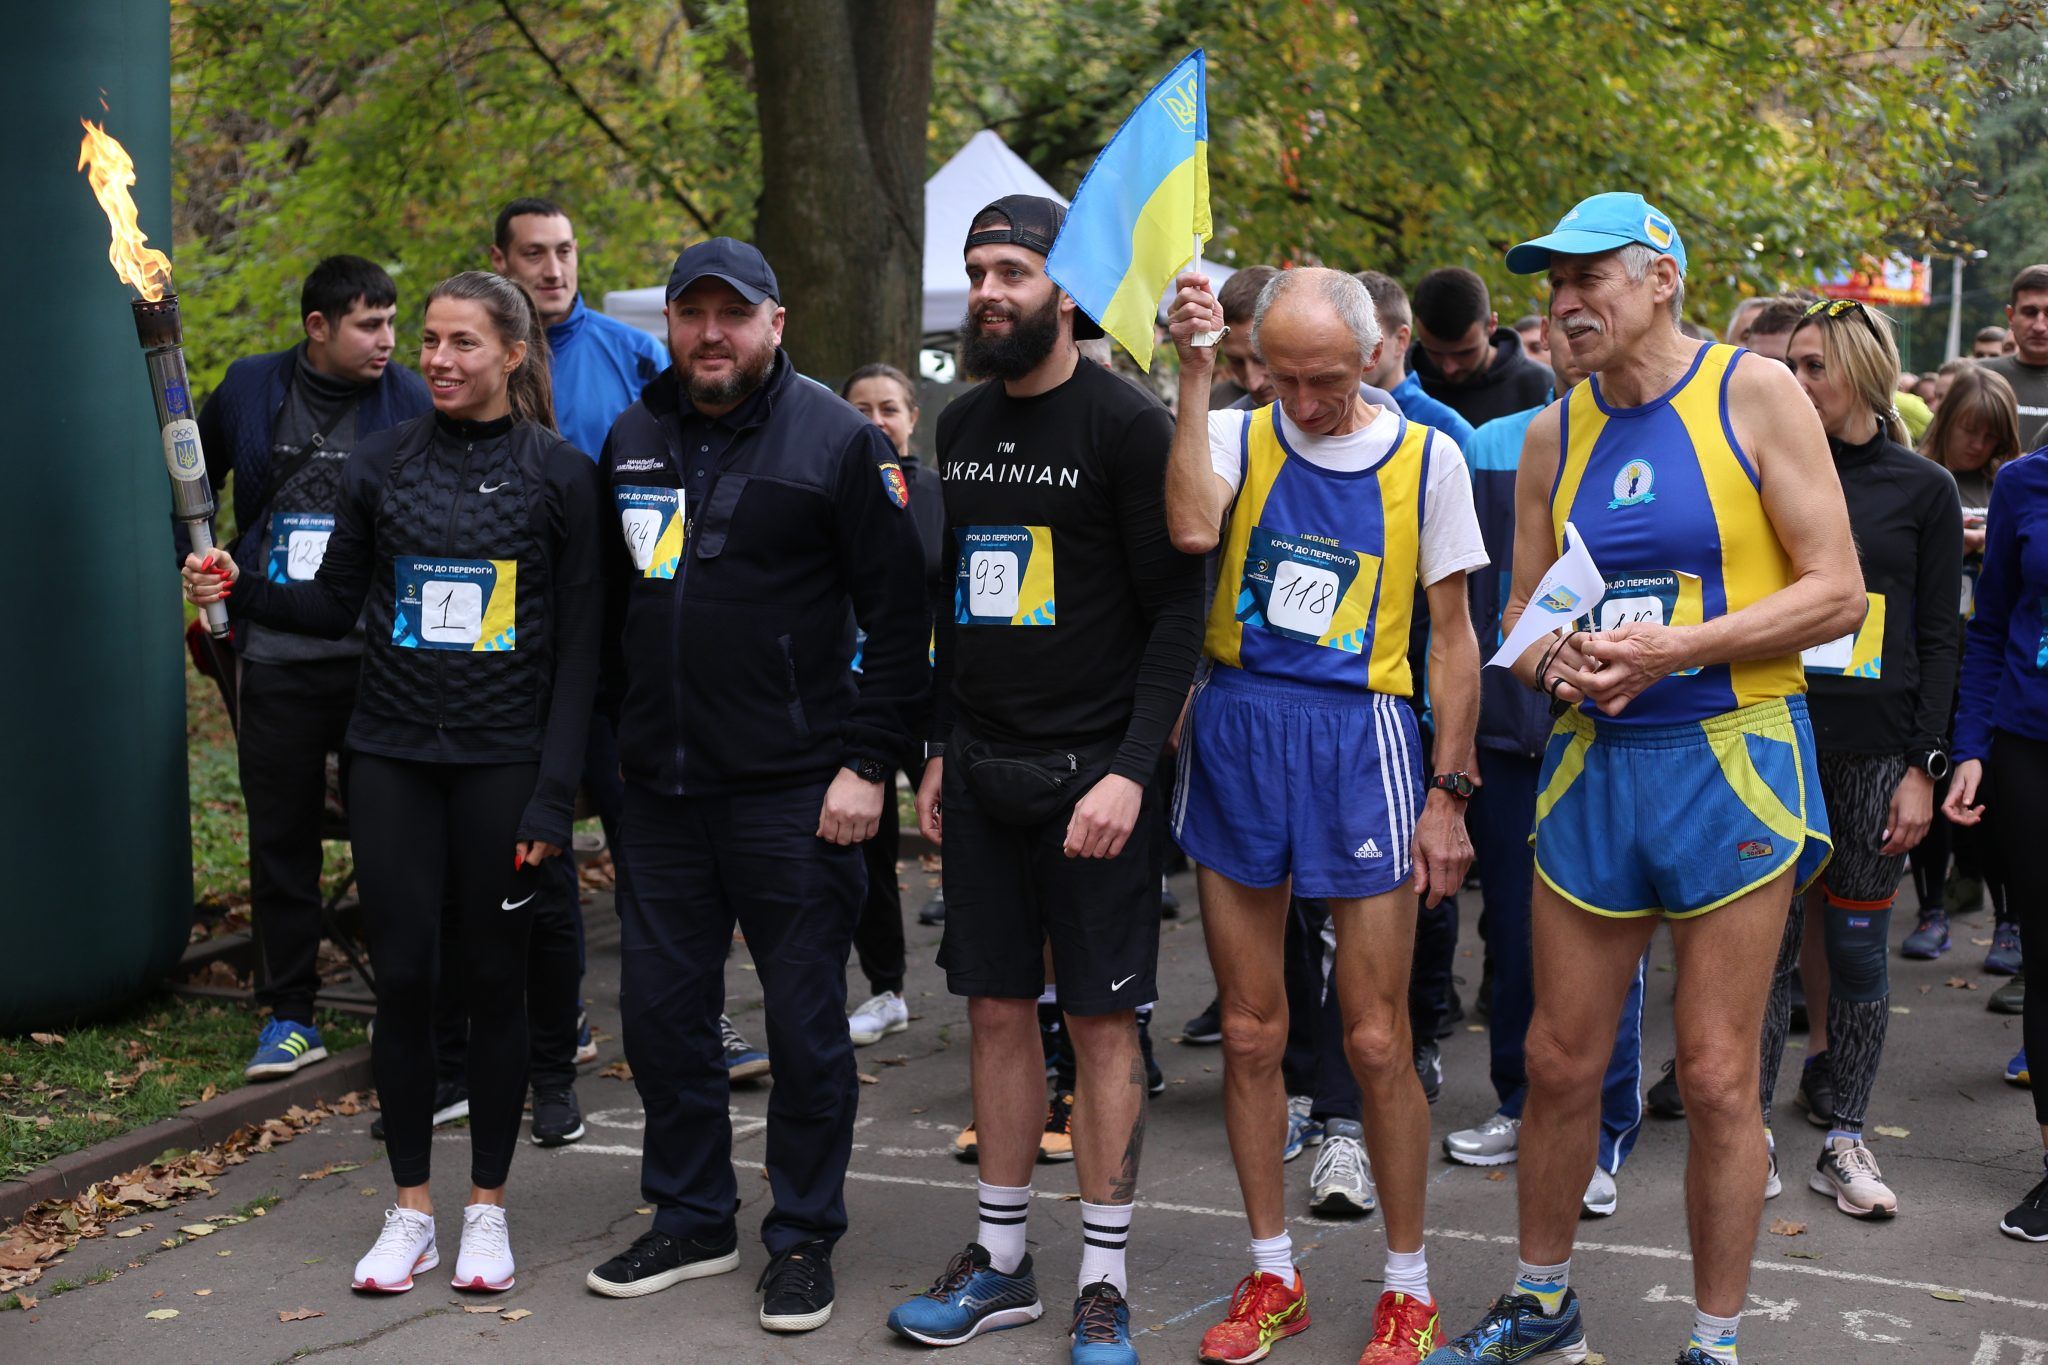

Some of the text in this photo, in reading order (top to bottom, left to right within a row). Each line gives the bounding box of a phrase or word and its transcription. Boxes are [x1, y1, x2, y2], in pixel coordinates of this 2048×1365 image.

[997, 442, 1016, 454] I'M
[630, 493, 642, 501] ДО
[641, 494, 677, 503] ПЕРЕМОГИ
[299, 518, 309, 526] ДО
[310, 518, 335, 527] ПЕРЕМО
[965, 534, 1028, 543] РОК ДО ПЕРЕМОГИ
[1271, 538, 1294, 552] КРОК
[1295, 545, 1309, 555] ДО
[1310, 549, 1356, 566] ПЕРЕМОГИ
[413, 563, 493, 575] КРОК ДО ПЕРЕМОГИ
[976, 559, 1005, 595] 93
[1613, 580, 1625, 589] ДО
[1627, 577, 1674, 587] ПЕРЕМОГИ
[1279, 576, 1334, 614] 118
[430, 589, 466, 630] 1
[1354, 850, 1383, 859] adidas
